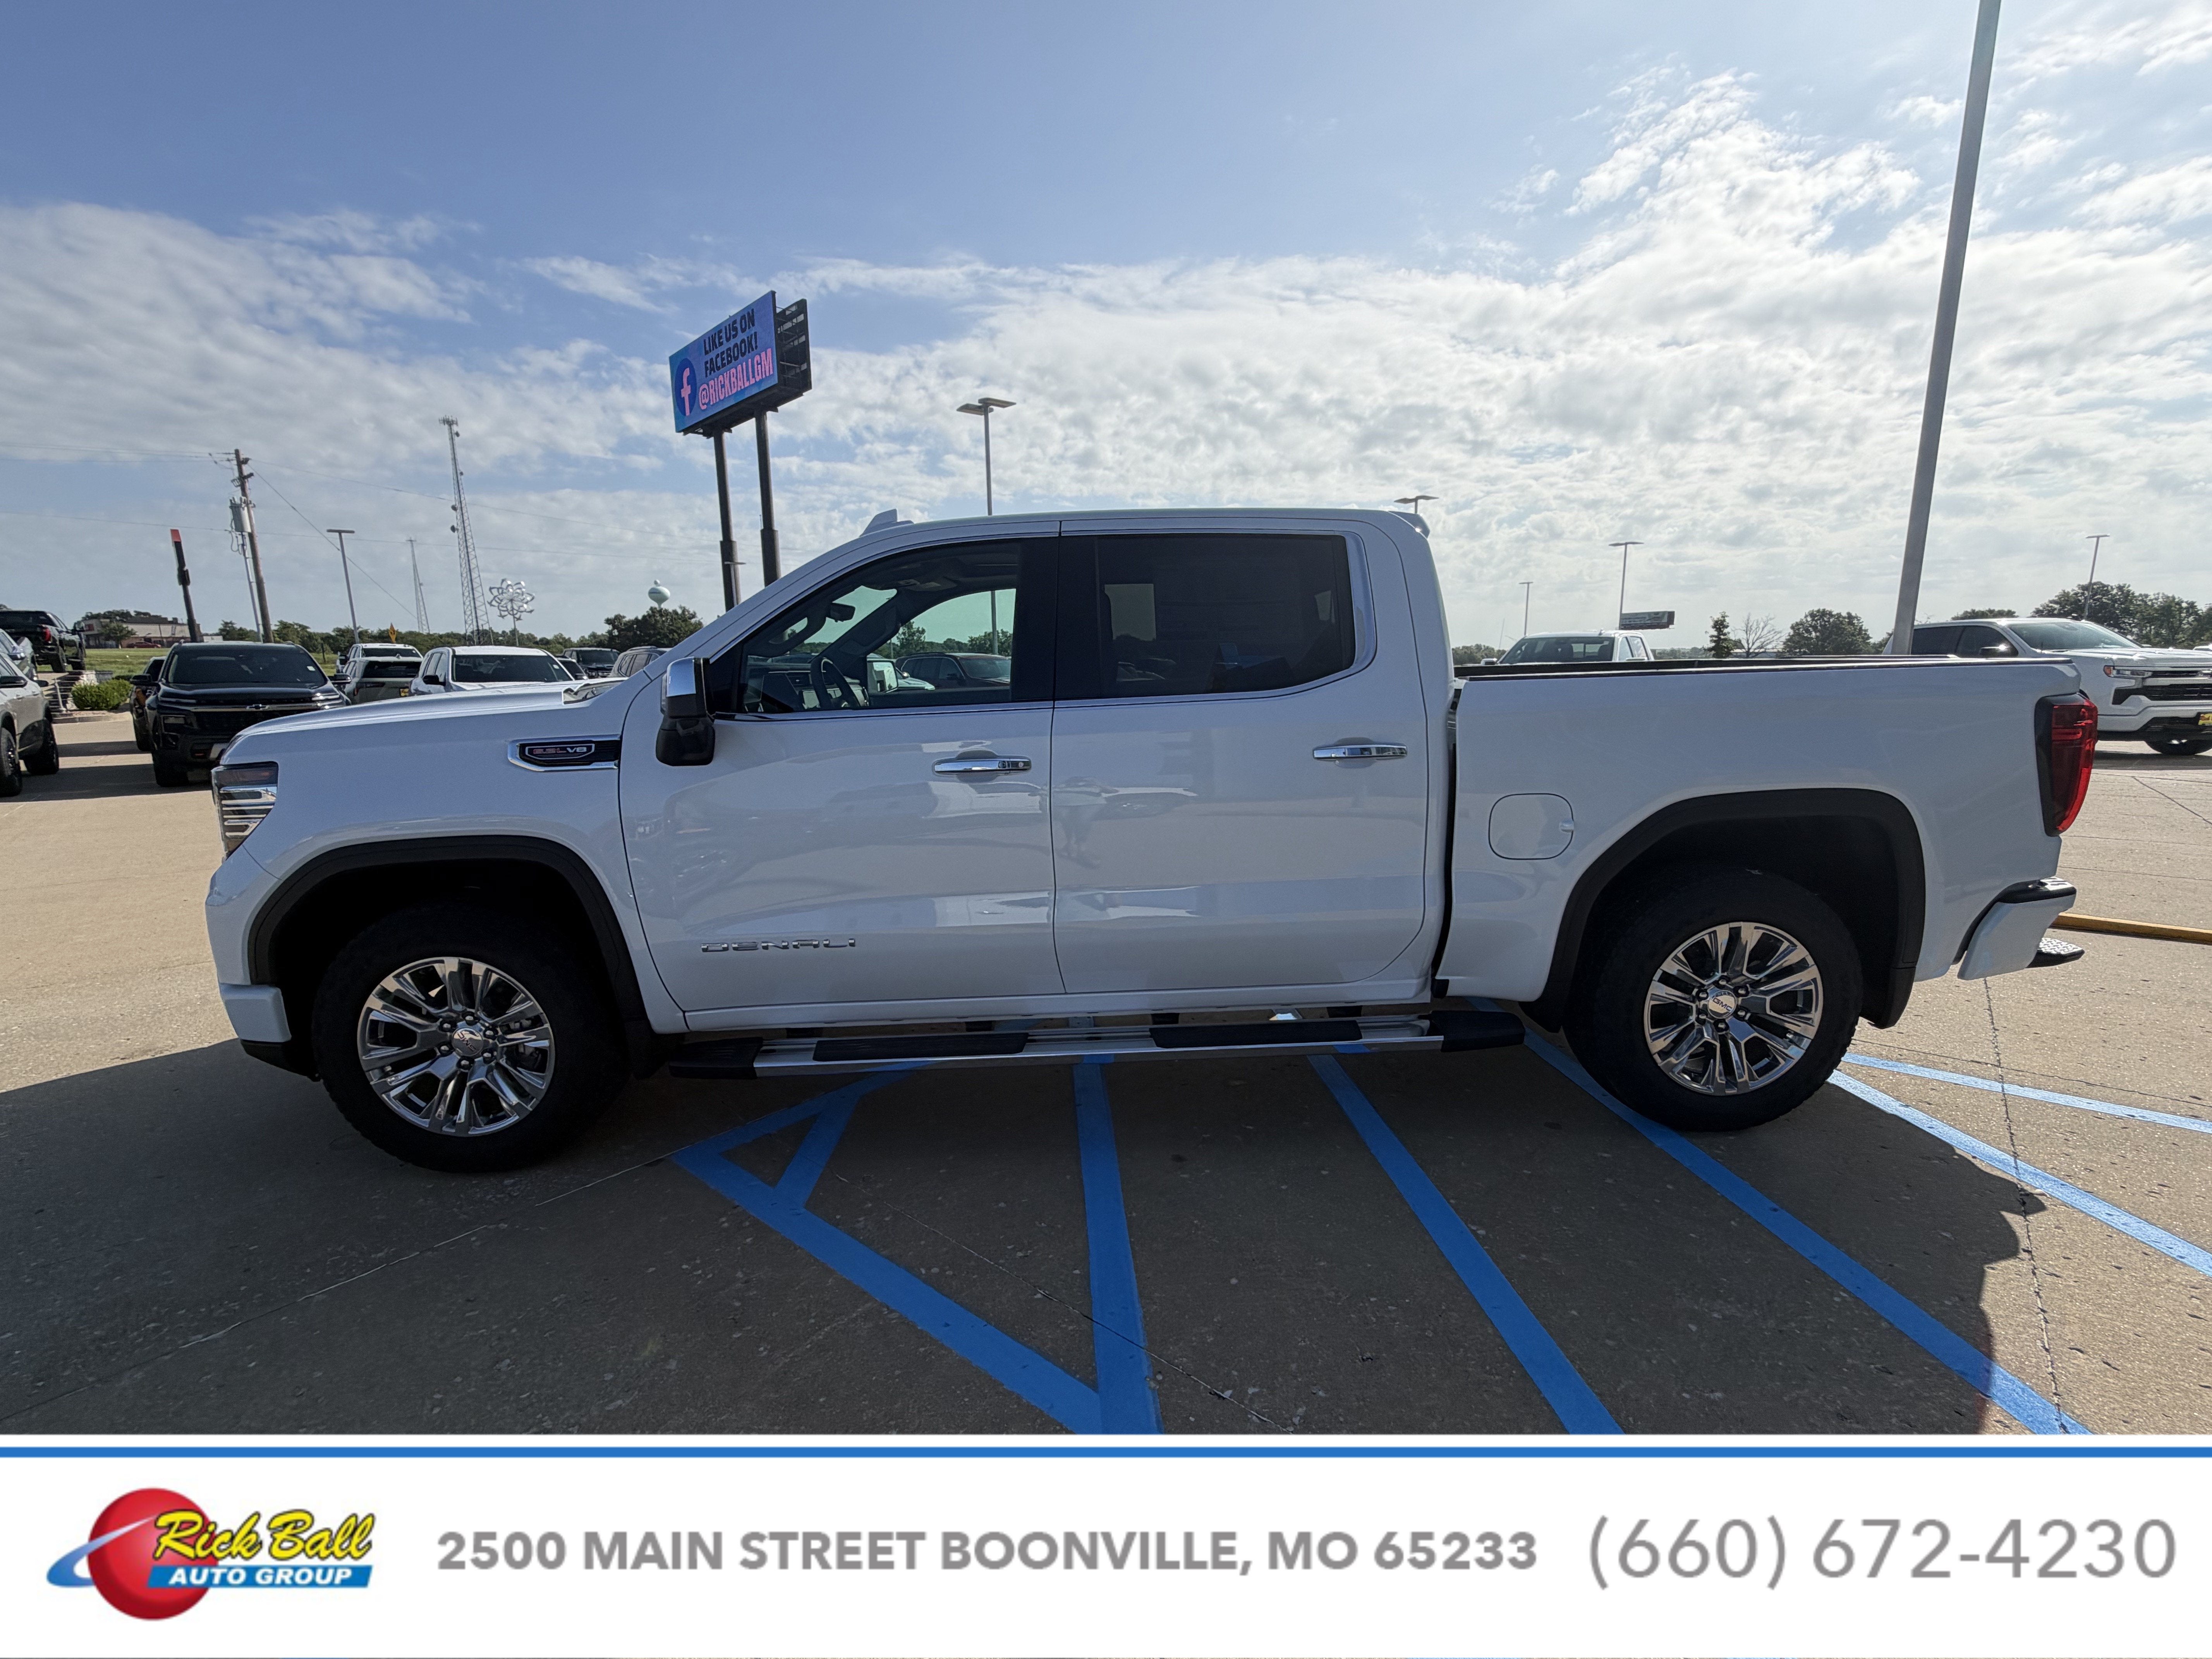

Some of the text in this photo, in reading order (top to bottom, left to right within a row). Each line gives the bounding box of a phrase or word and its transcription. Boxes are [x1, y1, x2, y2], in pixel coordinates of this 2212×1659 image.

[703, 309, 755, 356] LIKE US ON
[704, 331, 758, 378] FACEBOOK!
[699, 348, 773, 410] @RICKBALLGM
[701, 938, 856, 952] DENALI
[1712, 997, 1734, 1013] GMC
